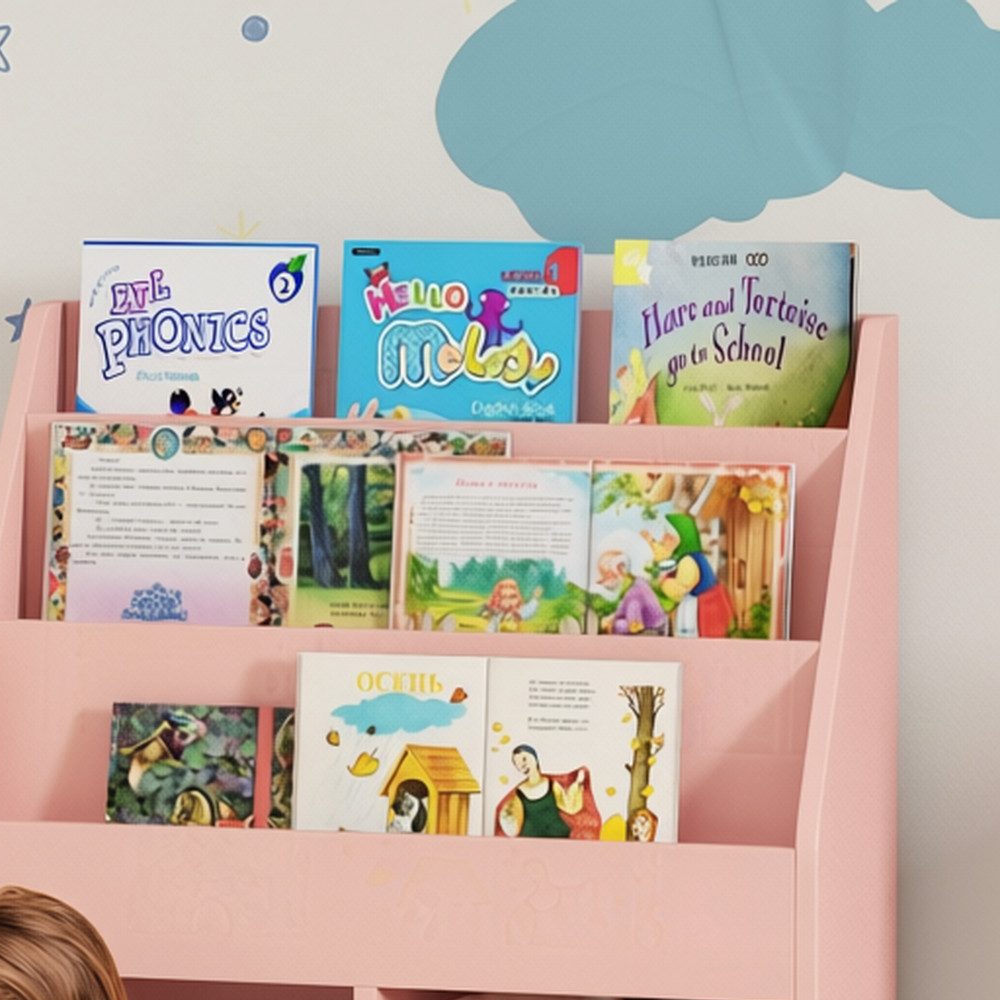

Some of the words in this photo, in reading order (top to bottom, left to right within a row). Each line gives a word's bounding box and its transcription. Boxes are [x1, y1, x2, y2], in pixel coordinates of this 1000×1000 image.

[279, 277, 290, 294] 2
[703, 287, 734, 317] and
[95, 307, 271, 381] PHONICS
[666, 353, 687, 388] go
[712, 322, 786, 370] School
